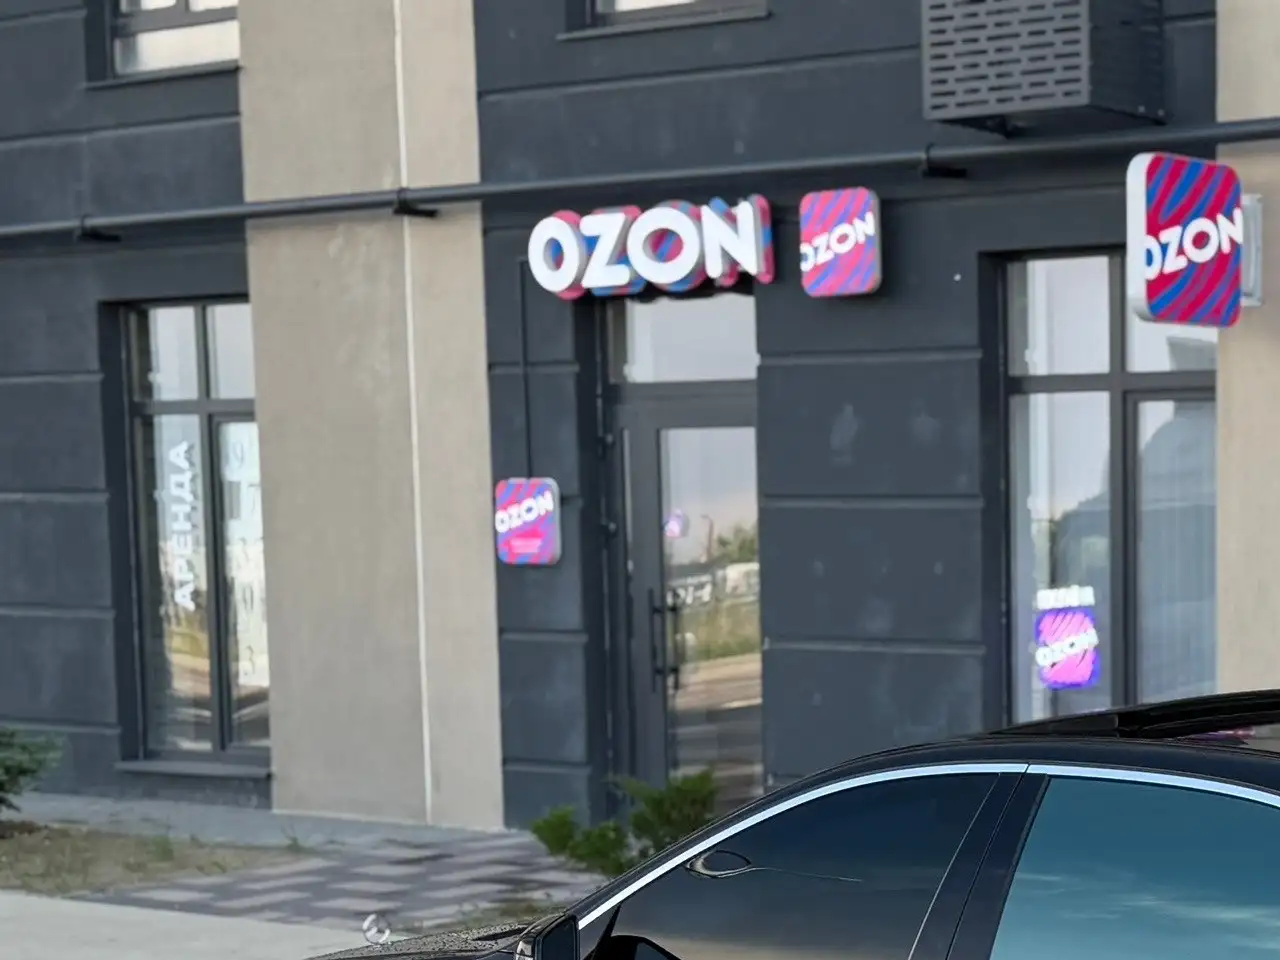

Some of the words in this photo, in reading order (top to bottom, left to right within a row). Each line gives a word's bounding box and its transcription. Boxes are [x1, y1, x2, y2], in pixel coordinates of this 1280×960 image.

[528, 199, 759, 293] OZON
[169, 440, 196, 612] АРЕНДА
[495, 489, 554, 533] OZON
[1035, 627, 1100, 667] OZON
